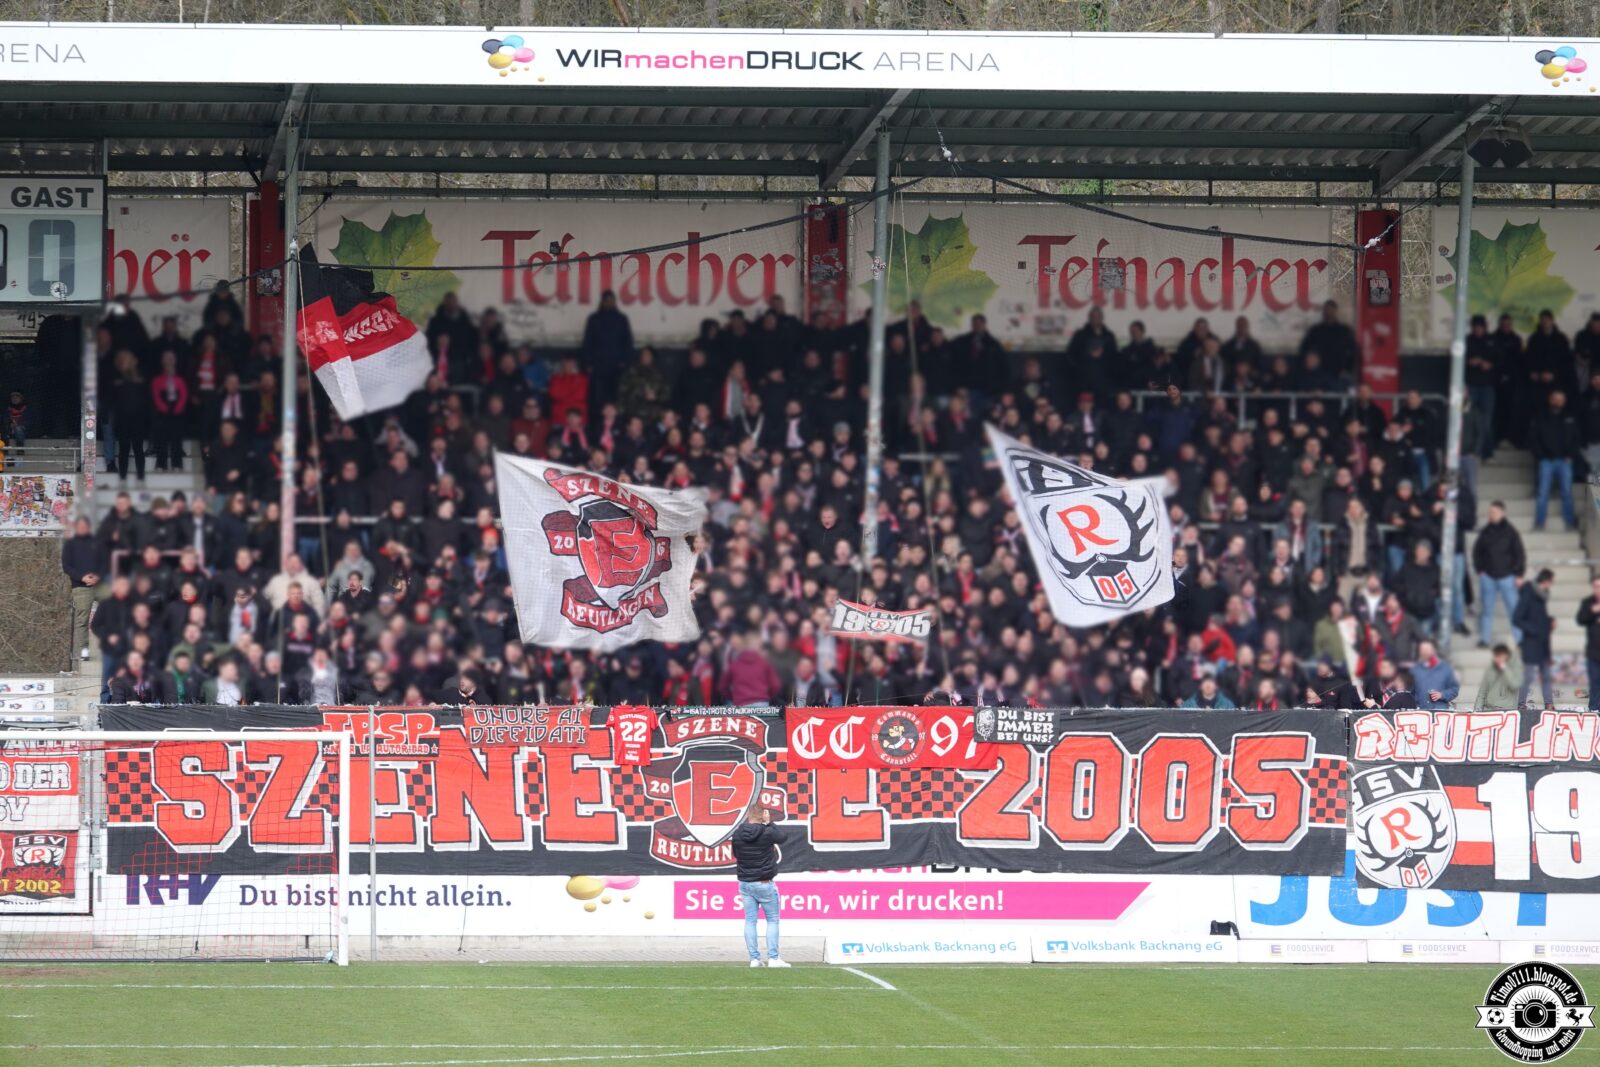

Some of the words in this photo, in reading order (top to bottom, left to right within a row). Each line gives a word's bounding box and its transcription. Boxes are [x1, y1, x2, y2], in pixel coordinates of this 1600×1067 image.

[0, 43, 86, 63] ENA
[555, 49, 865, 71] WIRmachenDRUCK
[873, 51, 1000, 72] ARENA
[11, 186, 94, 208] GAST
[481, 230, 796, 307] Teinacher
[1017, 234, 1328, 312] Teinacher
[1056, 505, 1119, 556] R
[553, 535, 574, 550] 20
[1097, 572, 1134, 599] 05
[997, 709, 1018, 720] DU
[1023, 711, 1054, 722] BIST
[619, 721, 648, 742] 22
[677, 717, 757, 739] SZENE
[997, 720, 1054, 734] IMMER
[1354, 711, 1600, 762] REUTLIN
[996, 732, 1018, 741] BEI
[1022, 733, 1054, 743] UNS!
[13, 762, 70, 790] DER
[650, 780, 670, 794] 20
[761, 792, 781, 807] 05
[1380, 807, 1422, 850] R
[18, 835, 64, 846] SSV
[657, 837, 735, 864] REUTLIN
[15, 879, 62, 895] 2002
[239, 884, 278, 906] Du
[287, 880, 339, 906] bist
[347, 880, 417, 907] nicht
[426, 881, 512, 907] allein.
[685, 889, 724, 911] Sie
[732, 894, 830, 914] sren,
[838, 889, 880, 911] wir
[887, 889, 1004, 911] drucken!
[865, 941, 930, 953] Volksbank
[935, 941, 996, 954] Backnang
[999, 941, 1017, 951] eG
[1071, 940, 1135, 952] Volksbank
[1140, 940, 1201, 953] Backnang
[1205, 941, 1223, 951] eG
[1286, 944, 1335, 952] FOODSERVICE
[1418, 944, 1467, 952] FOODSERVICE
[1550, 945, 1600, 953] FOODSERVICE
